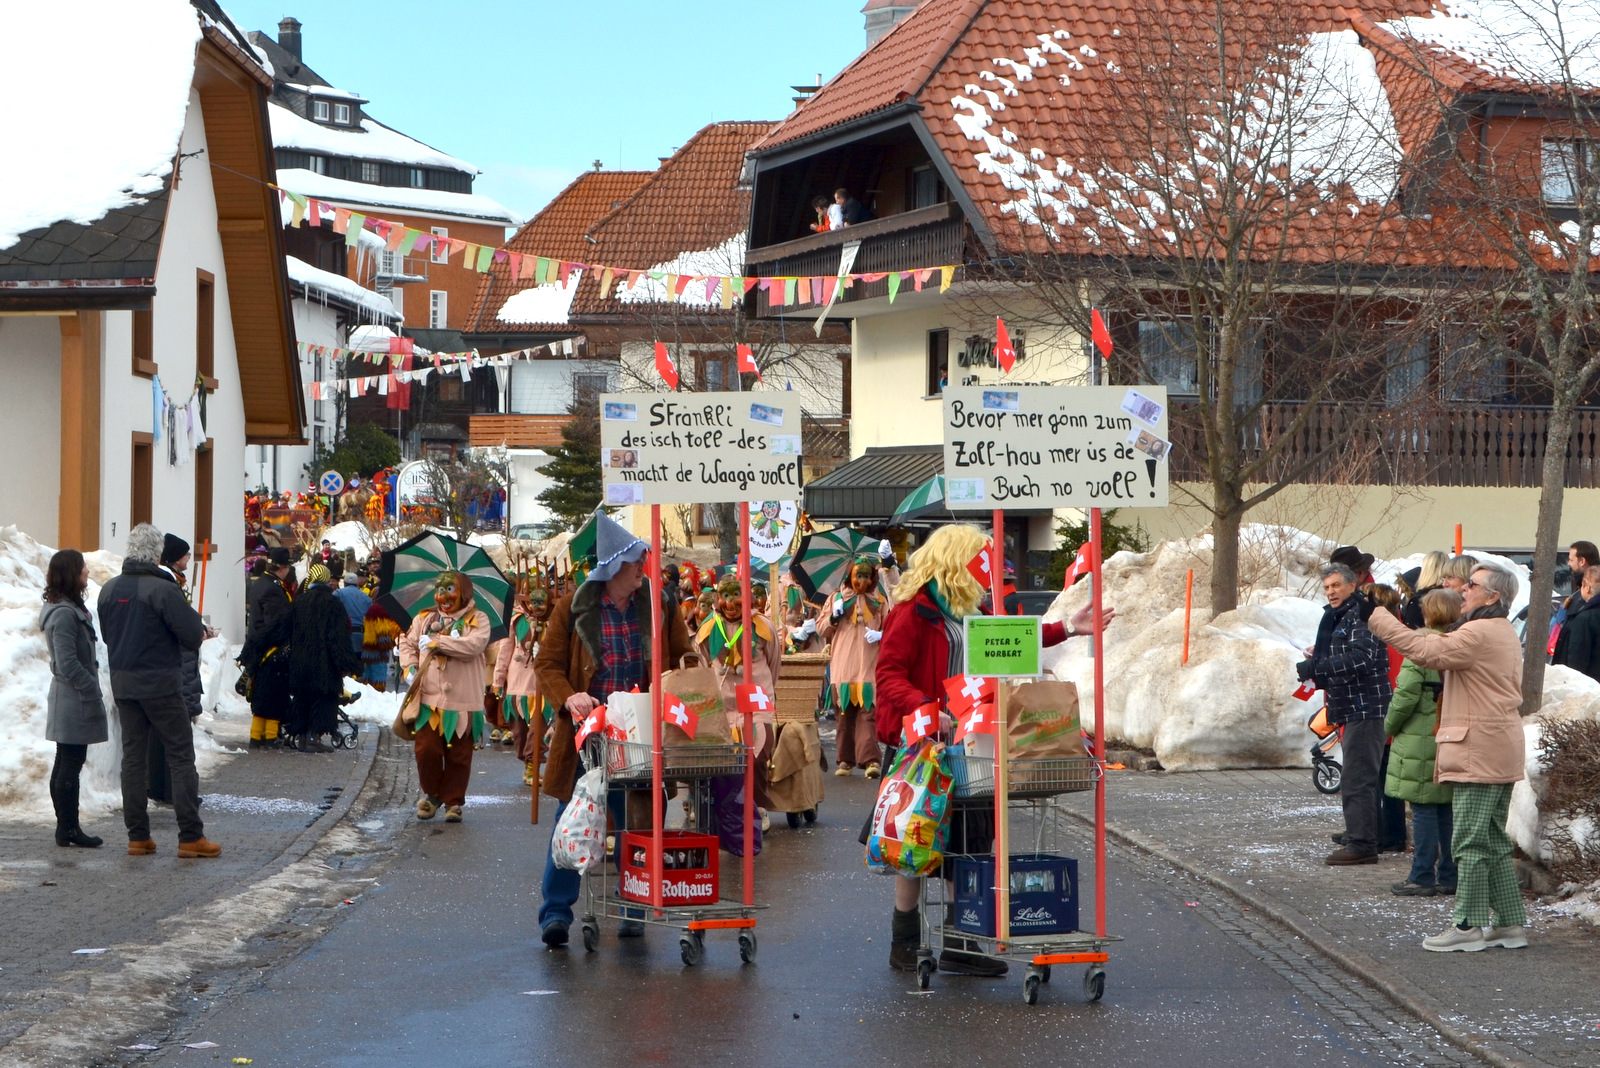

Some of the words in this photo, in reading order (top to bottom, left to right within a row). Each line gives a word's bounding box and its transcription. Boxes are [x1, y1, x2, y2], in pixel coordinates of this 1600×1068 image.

[950, 400, 1007, 430] Bevor
[1013, 413, 1044, 428] mer
[1048, 405, 1088, 435] gönn
[1094, 415, 1132, 431] zum
[621, 429, 647, 448] des
[651, 430, 682, 449] isch
[685, 429, 723, 449] toll
[1048, 447, 1080, 463] mer
[620, 463, 669, 482] macht
[676, 462, 693, 483] de
[991, 474, 1040, 500] Buch
[1050, 482, 1073, 497] no
[111, 522, 117, 538] 7
[985, 638, 1011, 646] PETER
[1014, 637, 1021, 646] &
[984, 649, 1023, 658] NORBERT
[623, 870, 650, 898] Rothaus
[661, 879, 713, 899] Rothaus
[1009, 920, 1057, 928] SCHLOSSBRUNNEN
